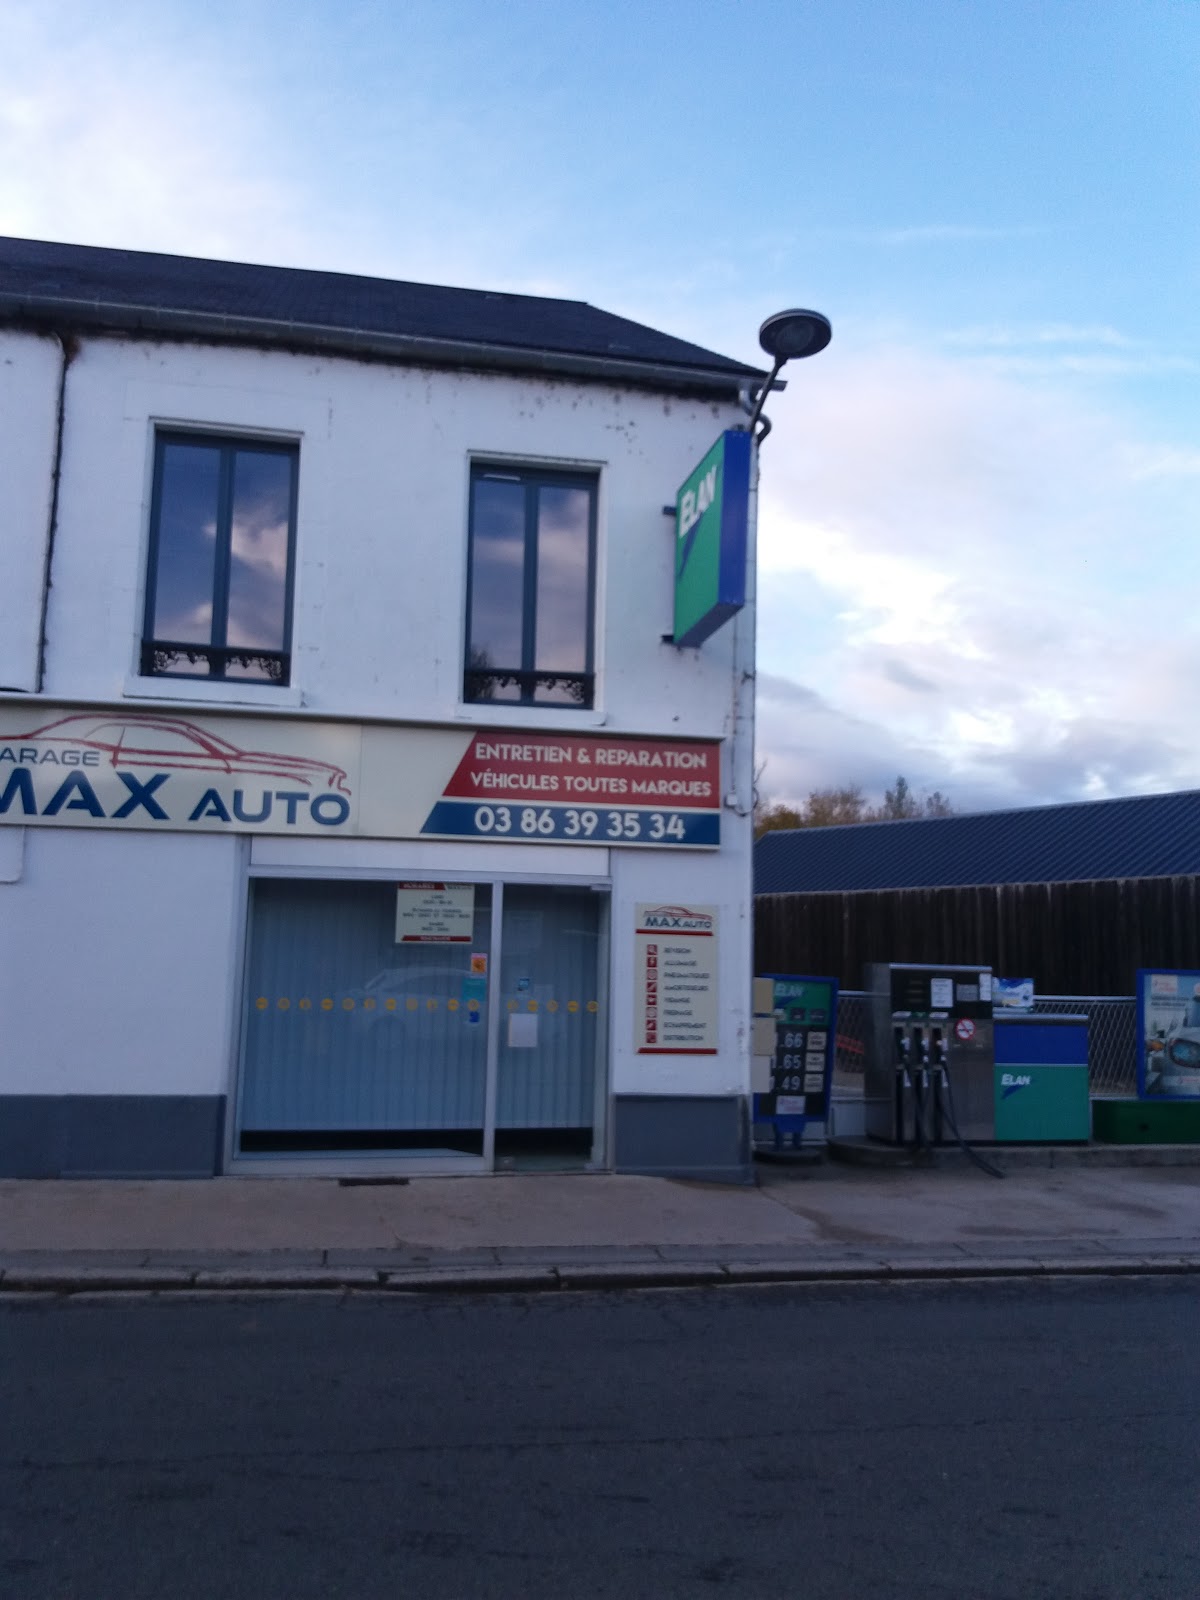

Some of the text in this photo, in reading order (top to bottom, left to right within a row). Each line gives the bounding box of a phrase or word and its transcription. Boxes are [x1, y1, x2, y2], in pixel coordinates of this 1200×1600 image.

[679, 464, 717, 540] ELAN
[0, 746, 100, 766] ARAGE
[475, 742, 707, 769] ENTRETIEN & REPARATION
[470, 768, 711, 797] VÉHICULES TOUTES MARQUES
[187, 788, 352, 826] AUTO
[474, 806, 685, 840] 03 86 39 35 34
[645, 917, 681, 928] MAX
[1000, 1073, 1032, 1086] ELAN
